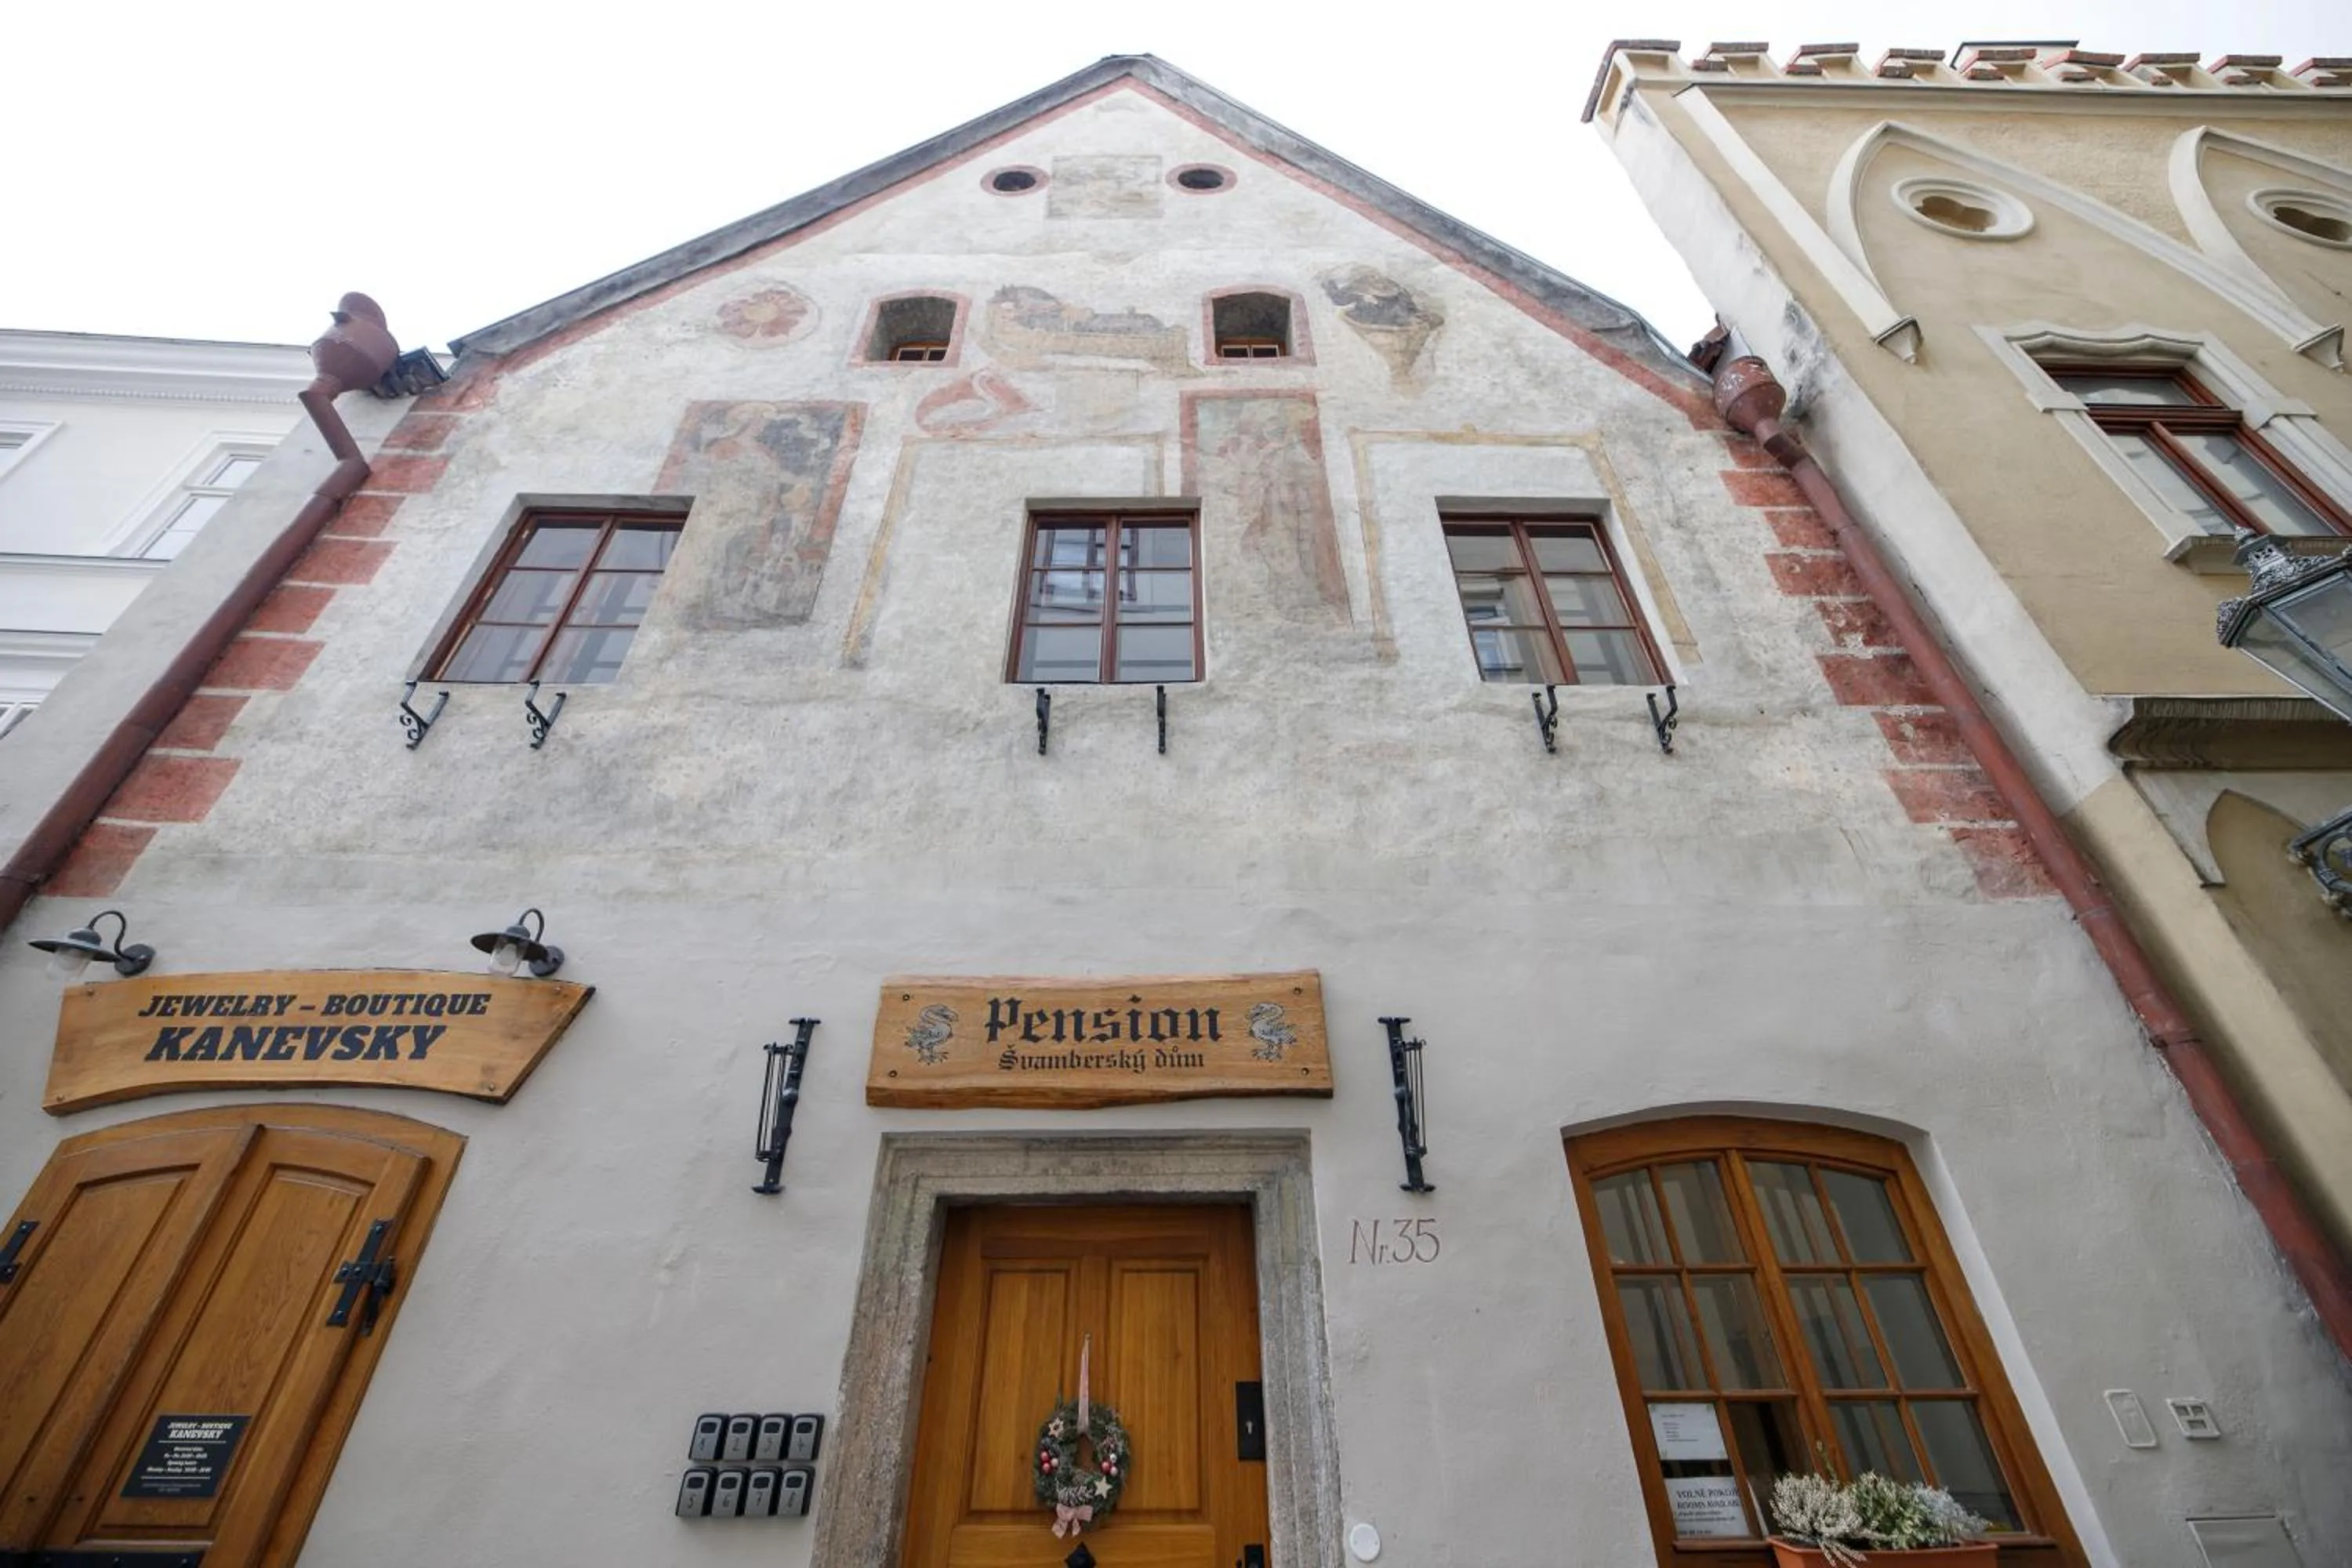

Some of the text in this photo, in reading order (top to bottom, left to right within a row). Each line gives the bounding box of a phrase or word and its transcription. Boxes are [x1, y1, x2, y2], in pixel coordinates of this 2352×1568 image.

[138, 994, 297, 1018] JEWELRY
[321, 993, 492, 1017] BOUTIQUE
[985, 994, 1223, 1044] Pension
[143, 1025, 447, 1062] KANEVSKY
[1154, 1045, 1204, 1069] dům
[169, 1429, 223, 1439] KANEVSKY
